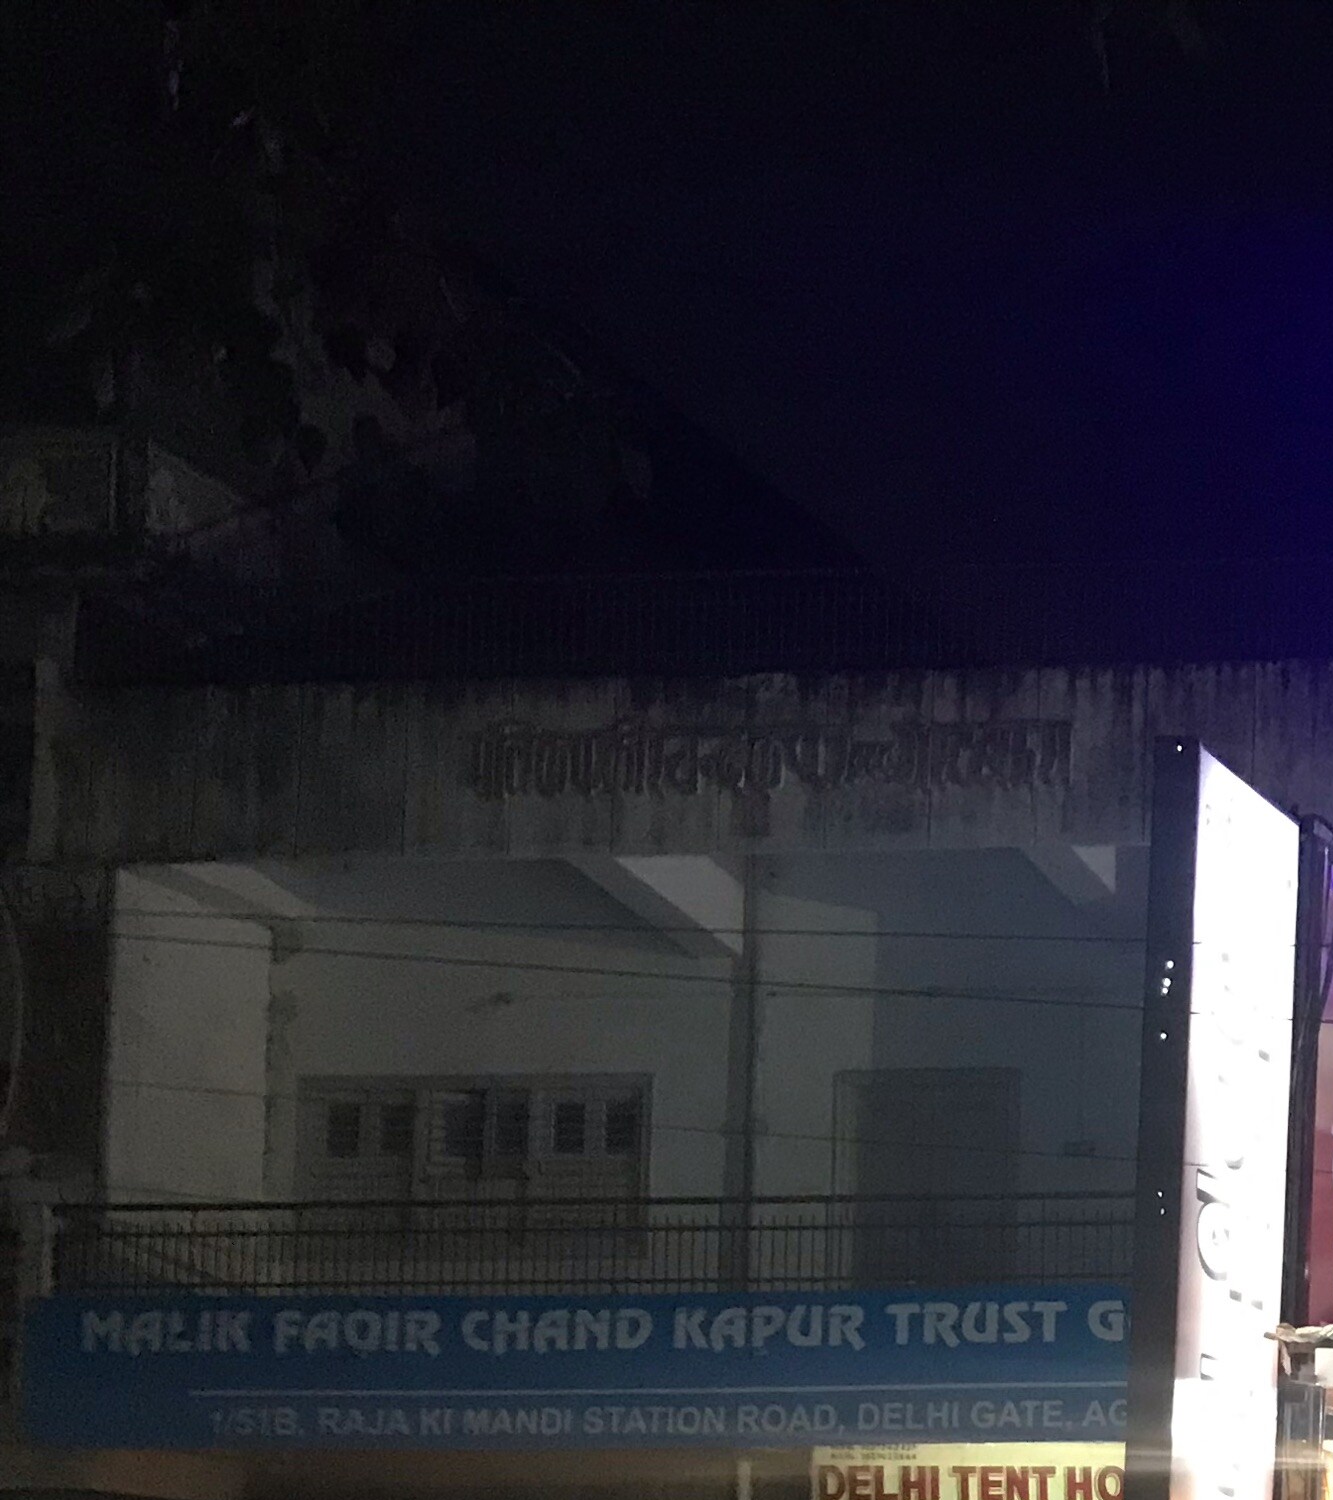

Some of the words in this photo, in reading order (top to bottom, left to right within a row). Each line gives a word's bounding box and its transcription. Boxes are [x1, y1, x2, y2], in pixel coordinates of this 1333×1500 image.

[81, 1308, 252, 1356] MALIK
[272, 1308, 444, 1358] FAQIR
[461, 1306, 653, 1354] CHAND
[672, 1302, 866, 1353] KAPUR
[885, 1299, 1068, 1349] TRUST
[317, 1406, 407, 1438] RAJA
[419, 1406, 453, 1437] KI
[462, 1405, 573, 1437] MANDI
[583, 1404, 729, 1436] STATION
[857, 1401, 960, 1431] DELHI
